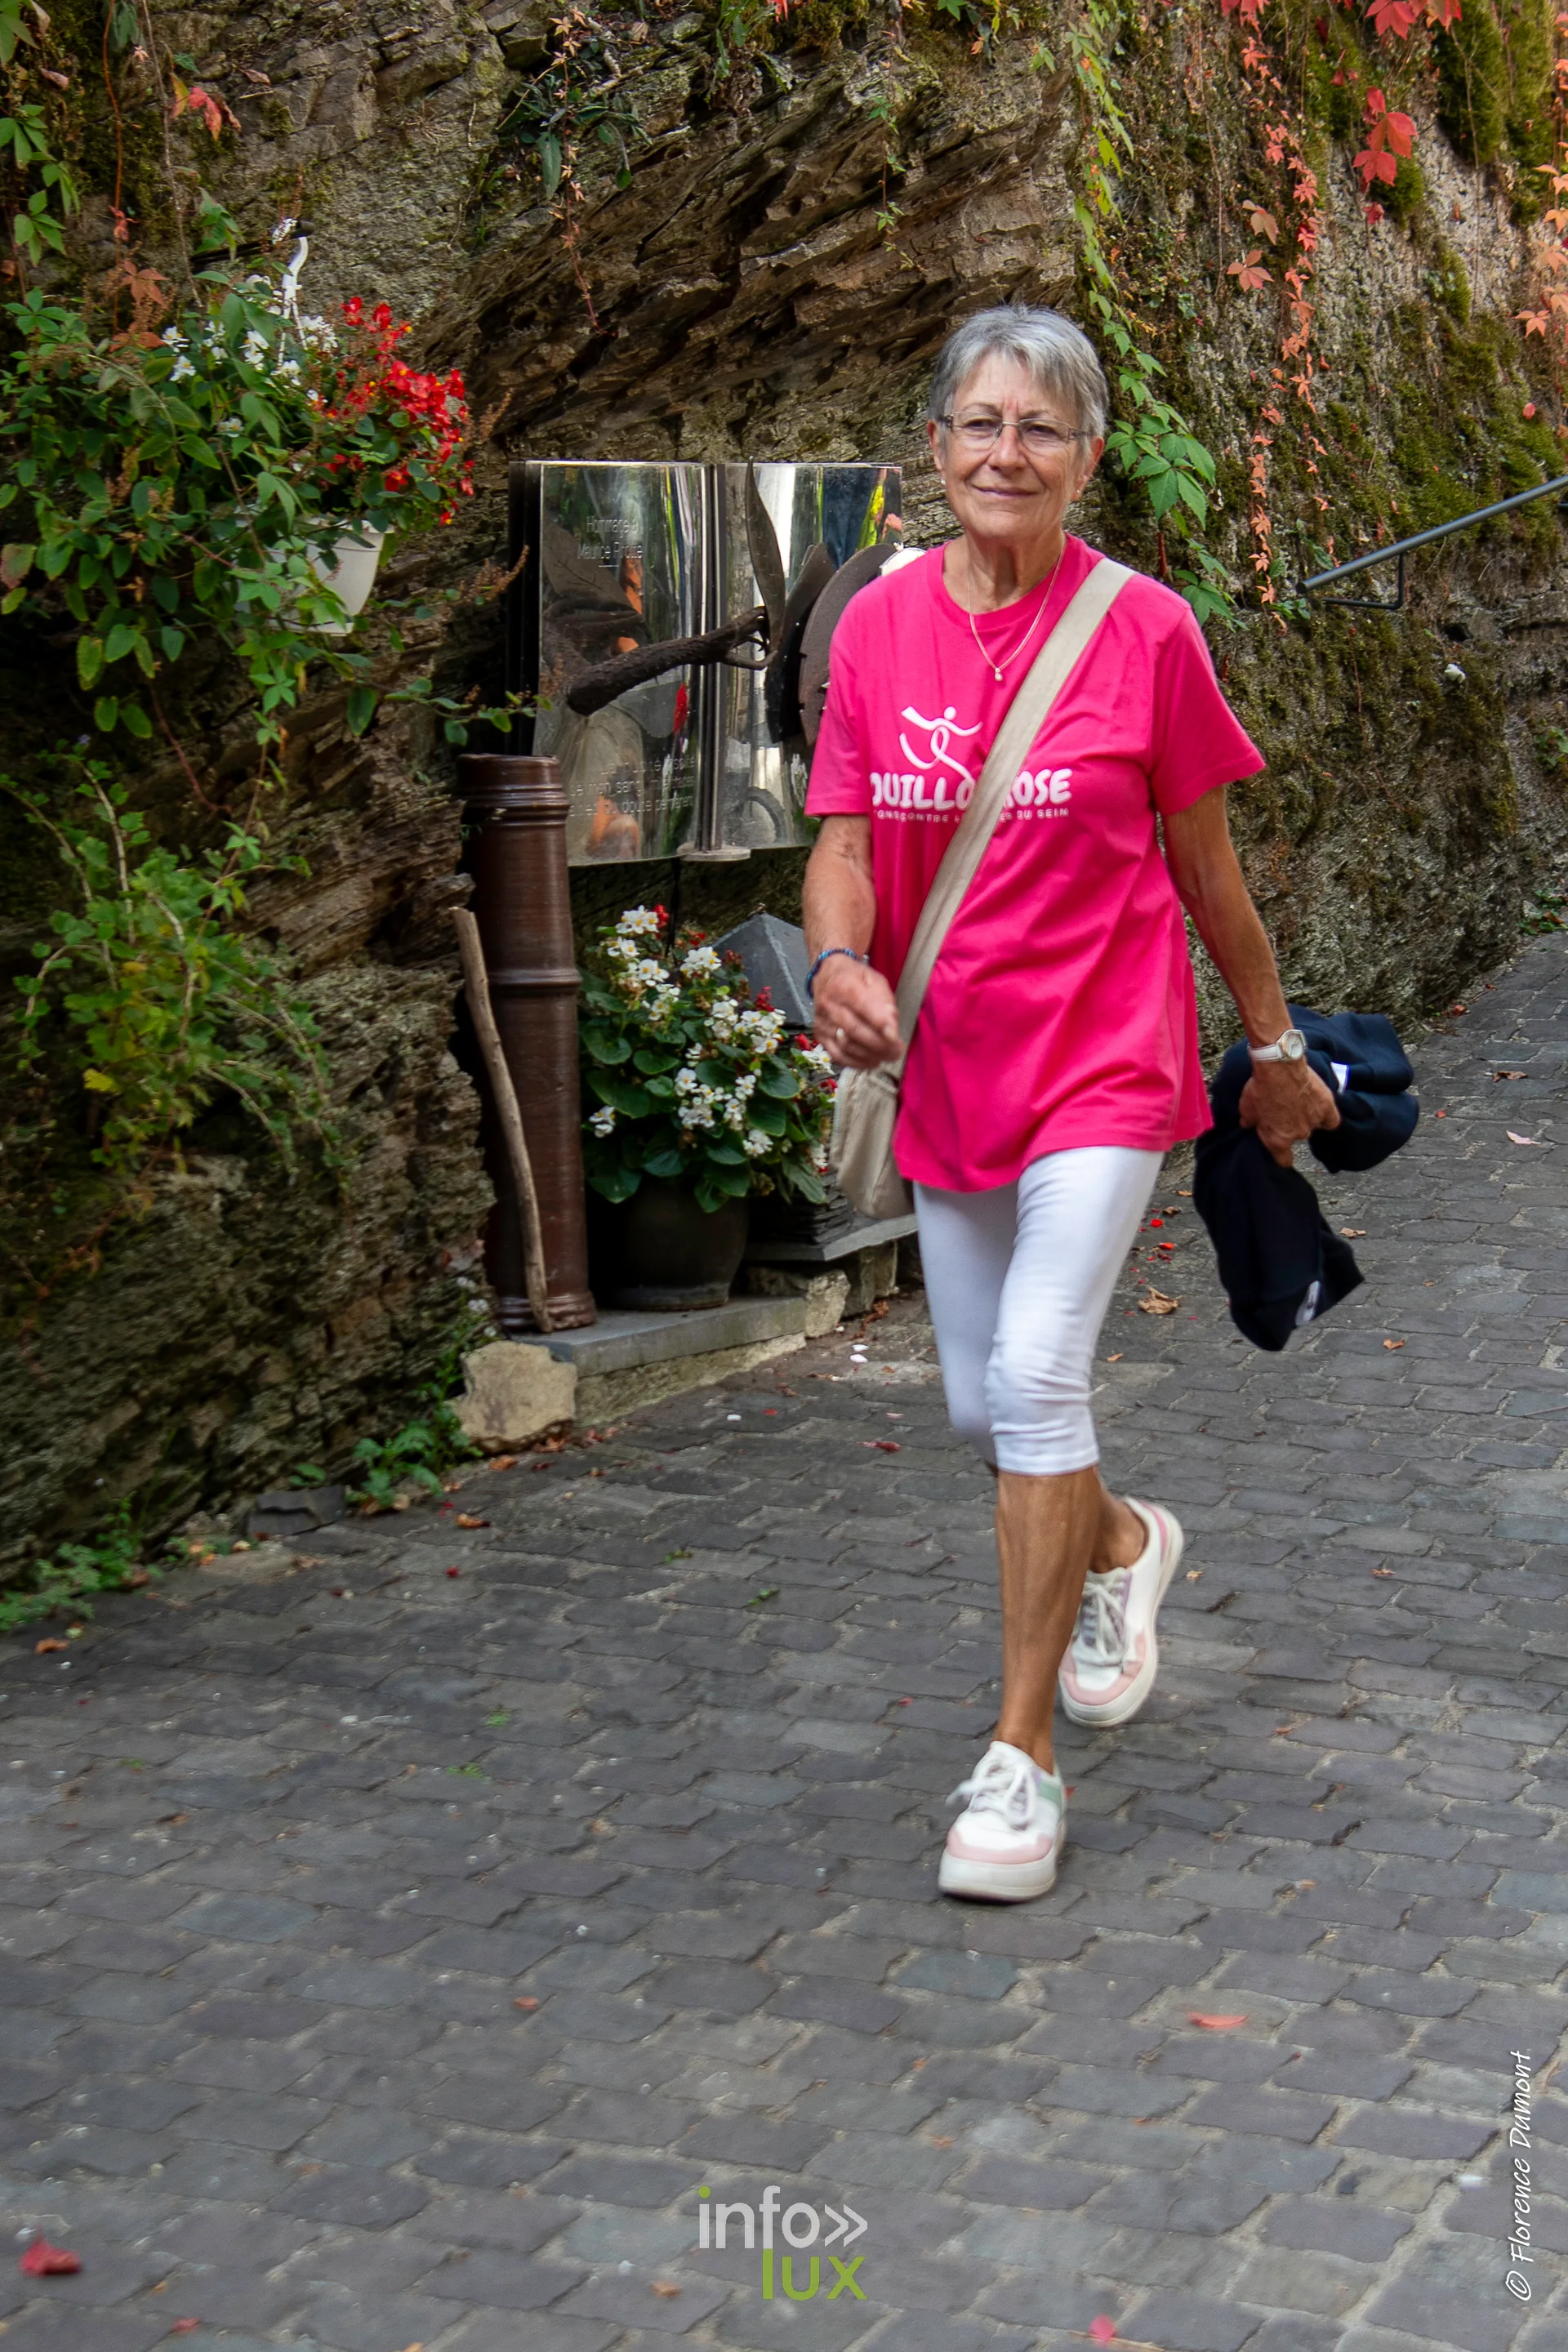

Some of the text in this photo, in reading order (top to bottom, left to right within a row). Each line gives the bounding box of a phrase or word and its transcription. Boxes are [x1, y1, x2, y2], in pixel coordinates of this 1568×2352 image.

[586, 516, 630, 538] Hommage
[577, 542, 611, 559] Maurice
[617, 780, 641, 798] sang
[869, 772, 977, 811] OUILLO
[1017, 810, 1032, 821] DU
[1036, 807, 1069, 820] SEIN
